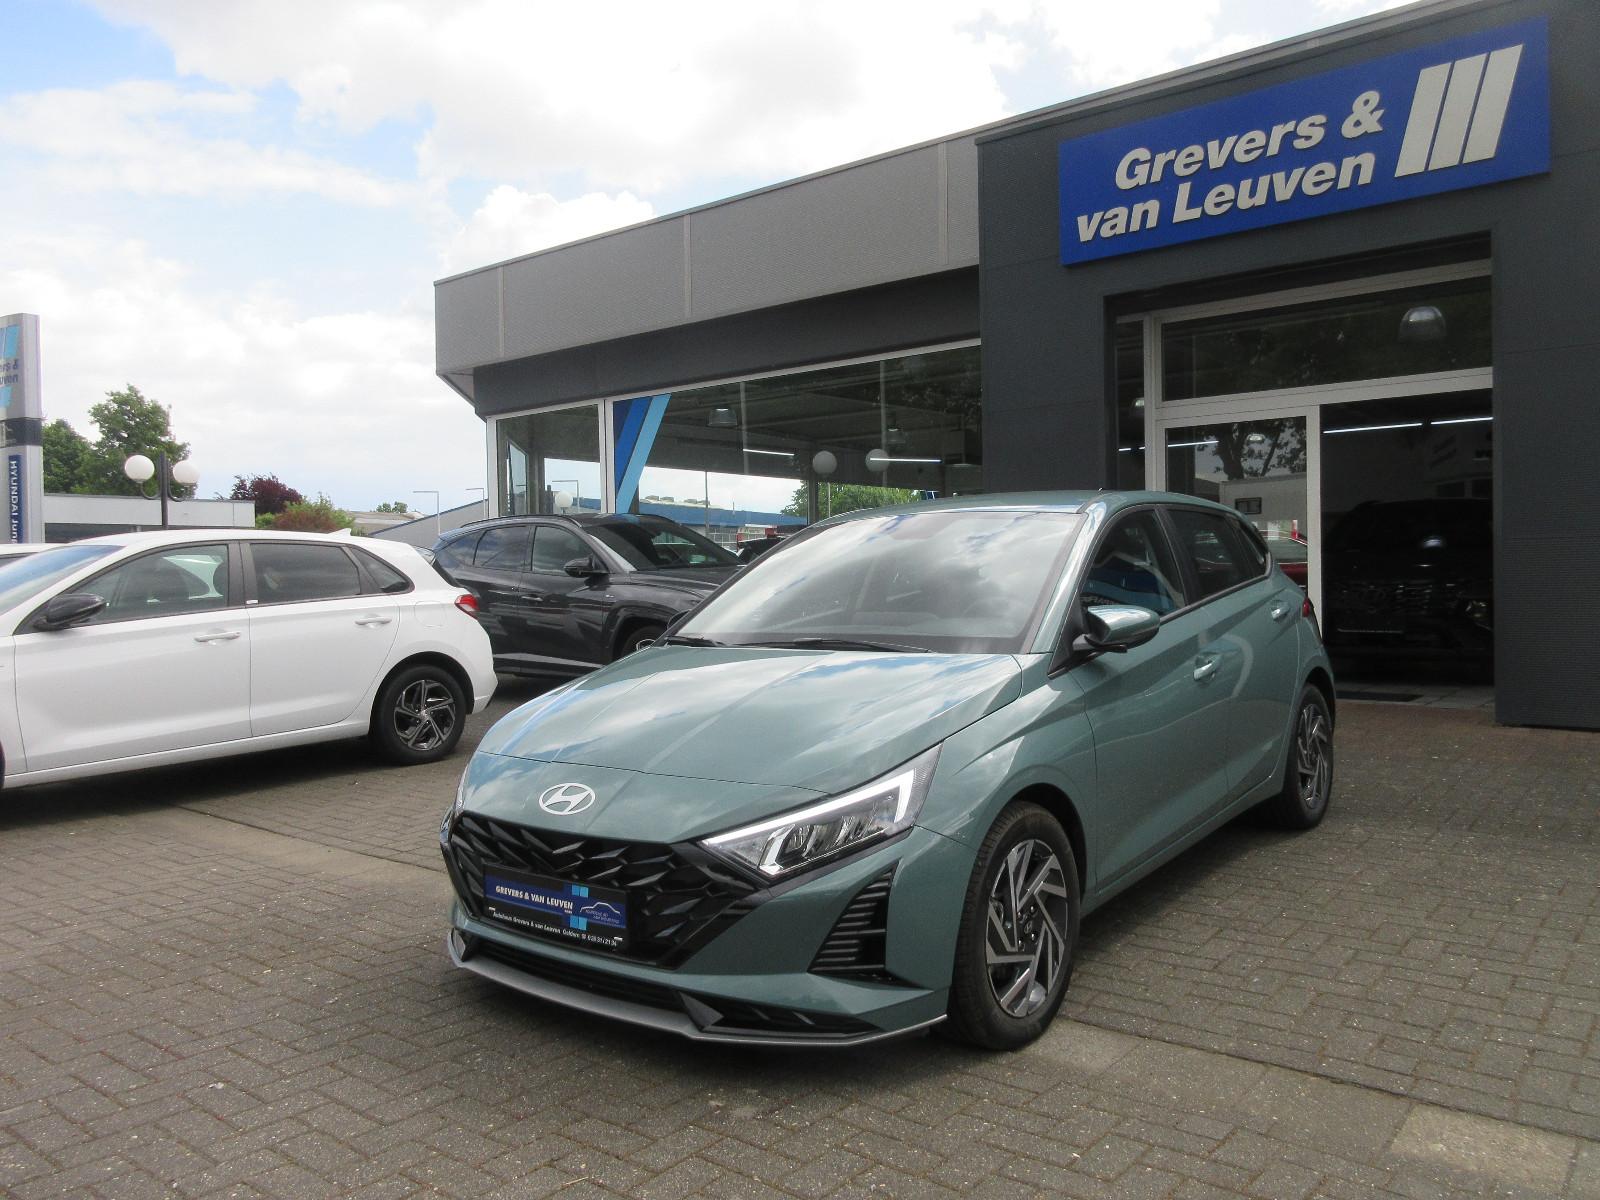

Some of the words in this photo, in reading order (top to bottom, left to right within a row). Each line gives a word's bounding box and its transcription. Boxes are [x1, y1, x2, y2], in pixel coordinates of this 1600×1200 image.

[1114, 113, 1327, 190] Grevers
[1340, 89, 1386, 139] &
[1077, 199, 1161, 242] van
[1172, 152, 1376, 223] Leuven
[10, 460, 19, 516] HYUNDAI
[495, 885, 523, 899] GREVERS
[524, 892, 529, 901] &
[531, 893, 545, 904] VAN
[547, 896, 574, 909] LEUVEN
